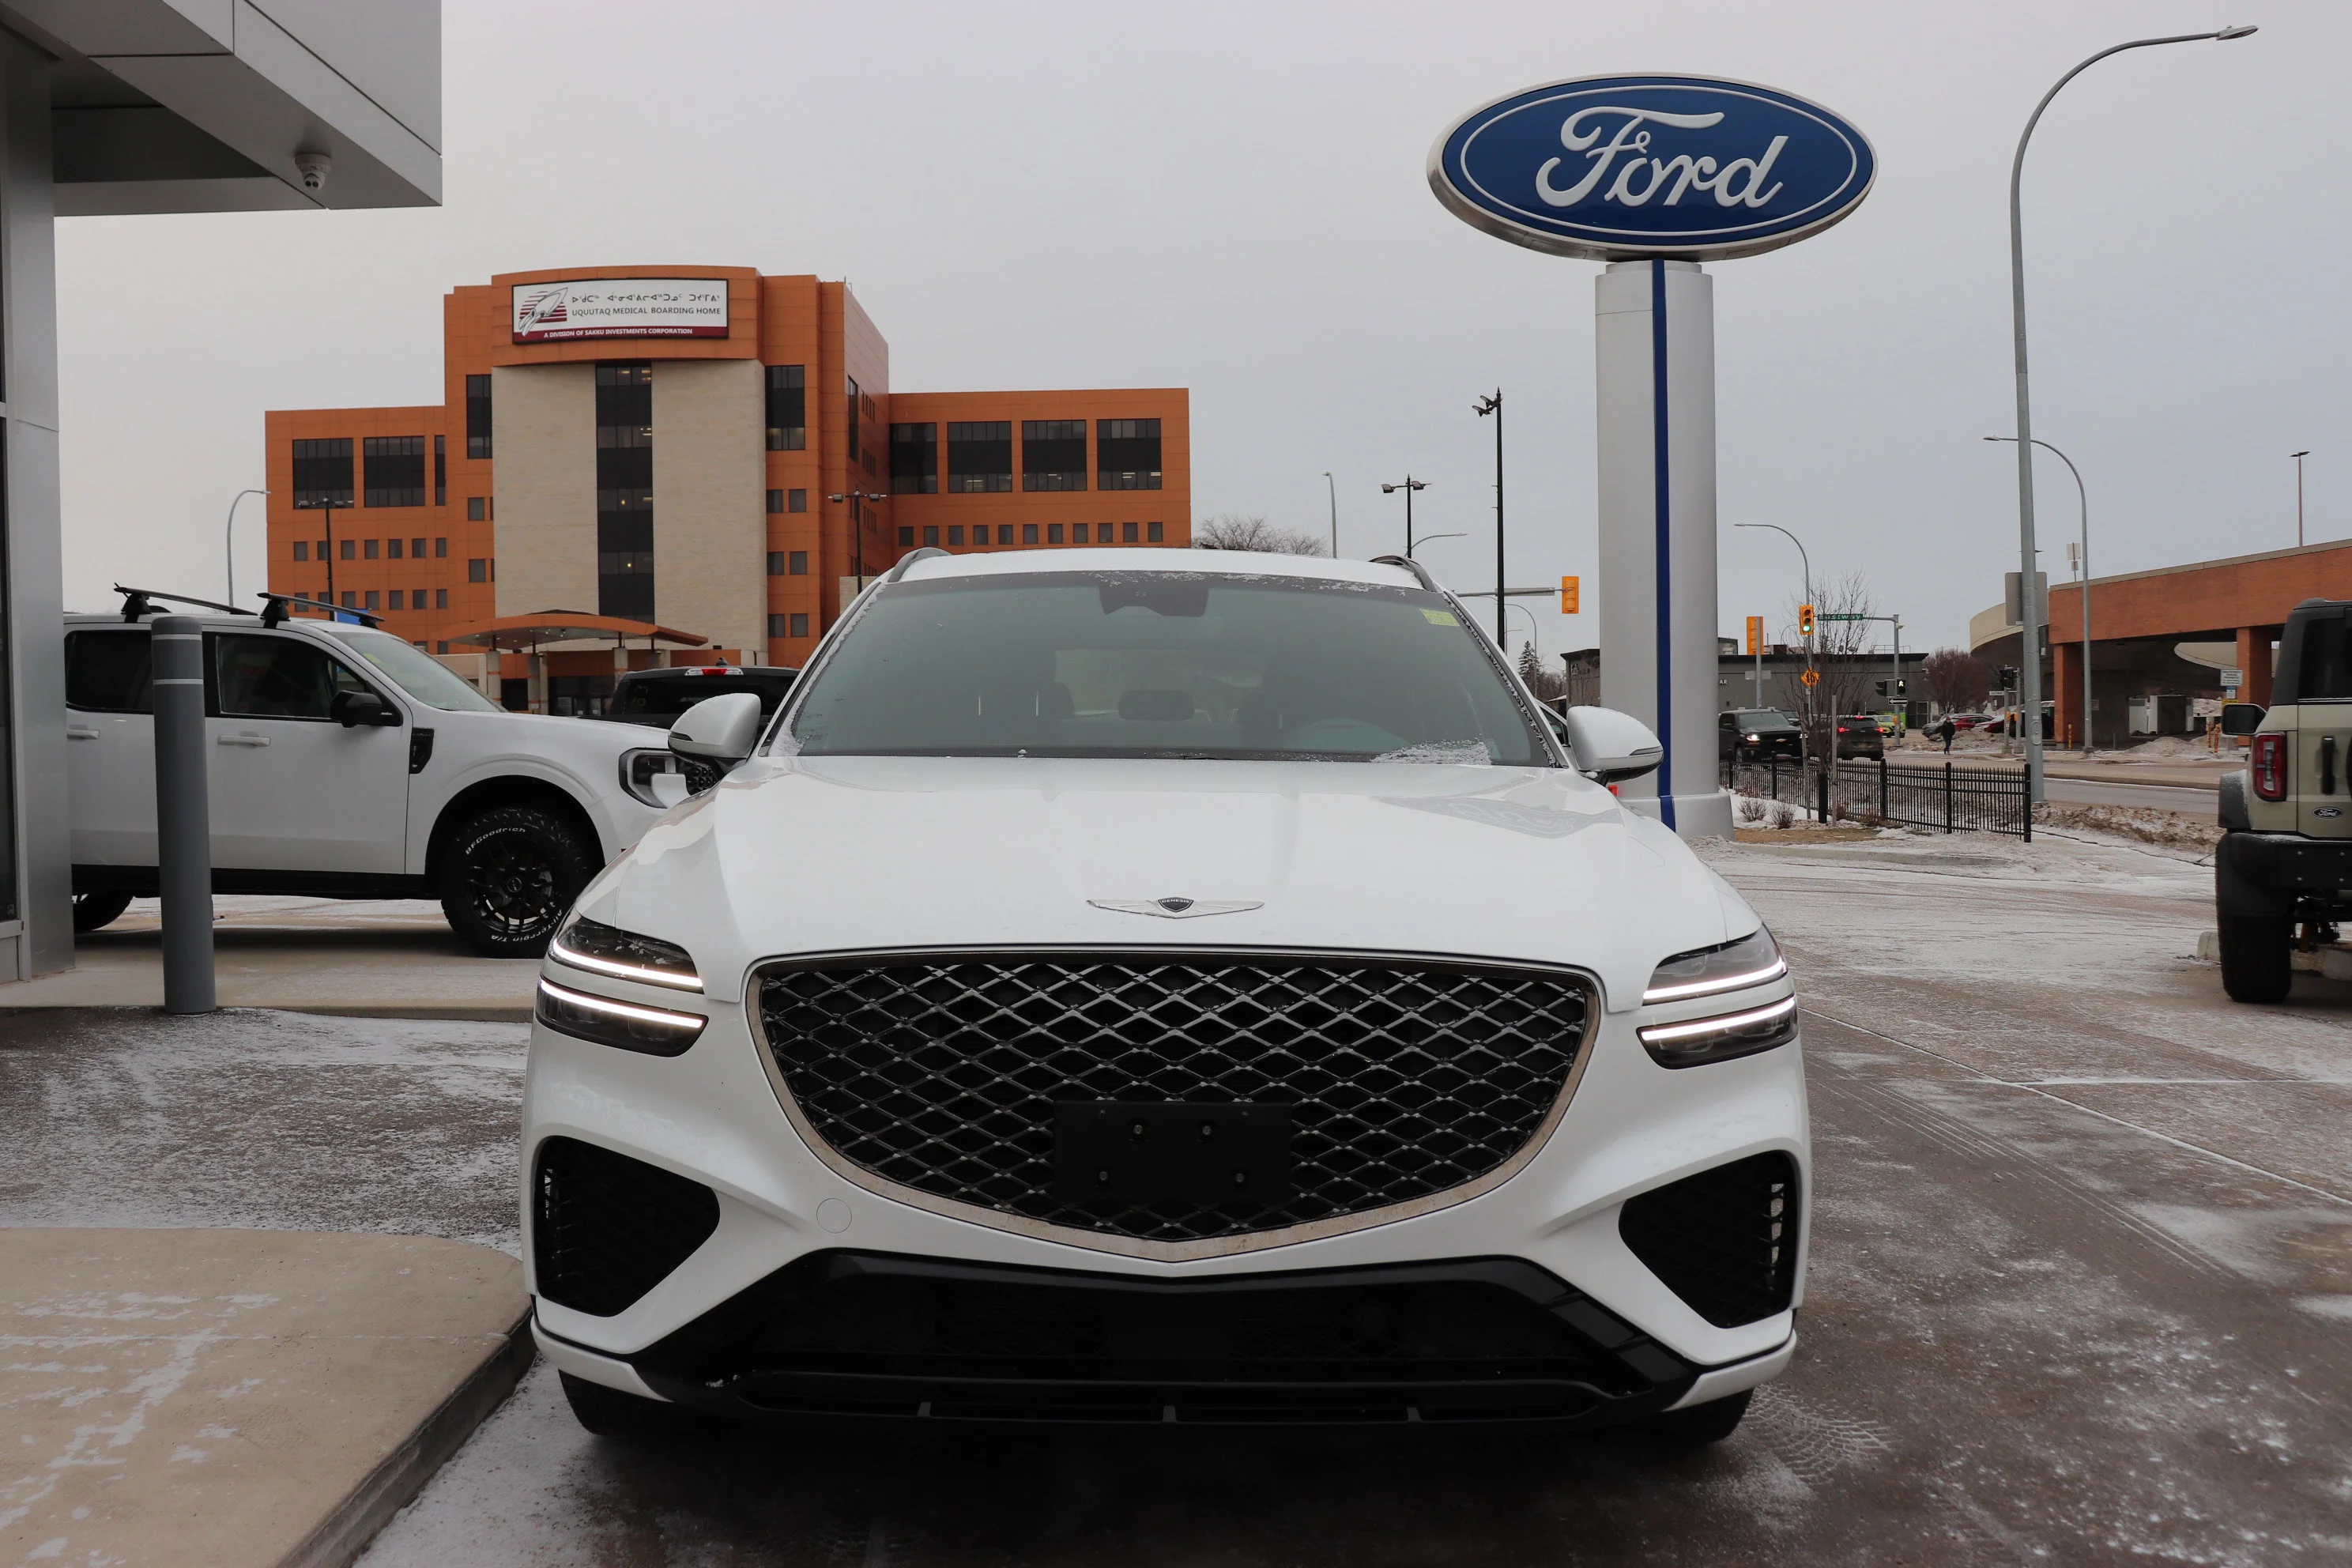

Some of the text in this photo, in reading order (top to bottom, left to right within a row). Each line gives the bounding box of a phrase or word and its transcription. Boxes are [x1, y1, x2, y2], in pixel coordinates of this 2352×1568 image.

[1536, 106, 1788, 209] Ford
[571, 307, 611, 317] UQUUTAQ
[612, 307, 647, 315] MEDICAL
[549, 330, 575, 338] DIVISION
[466, 827, 526, 855] BFGoodrich
[491, 934, 507, 943] T/A
